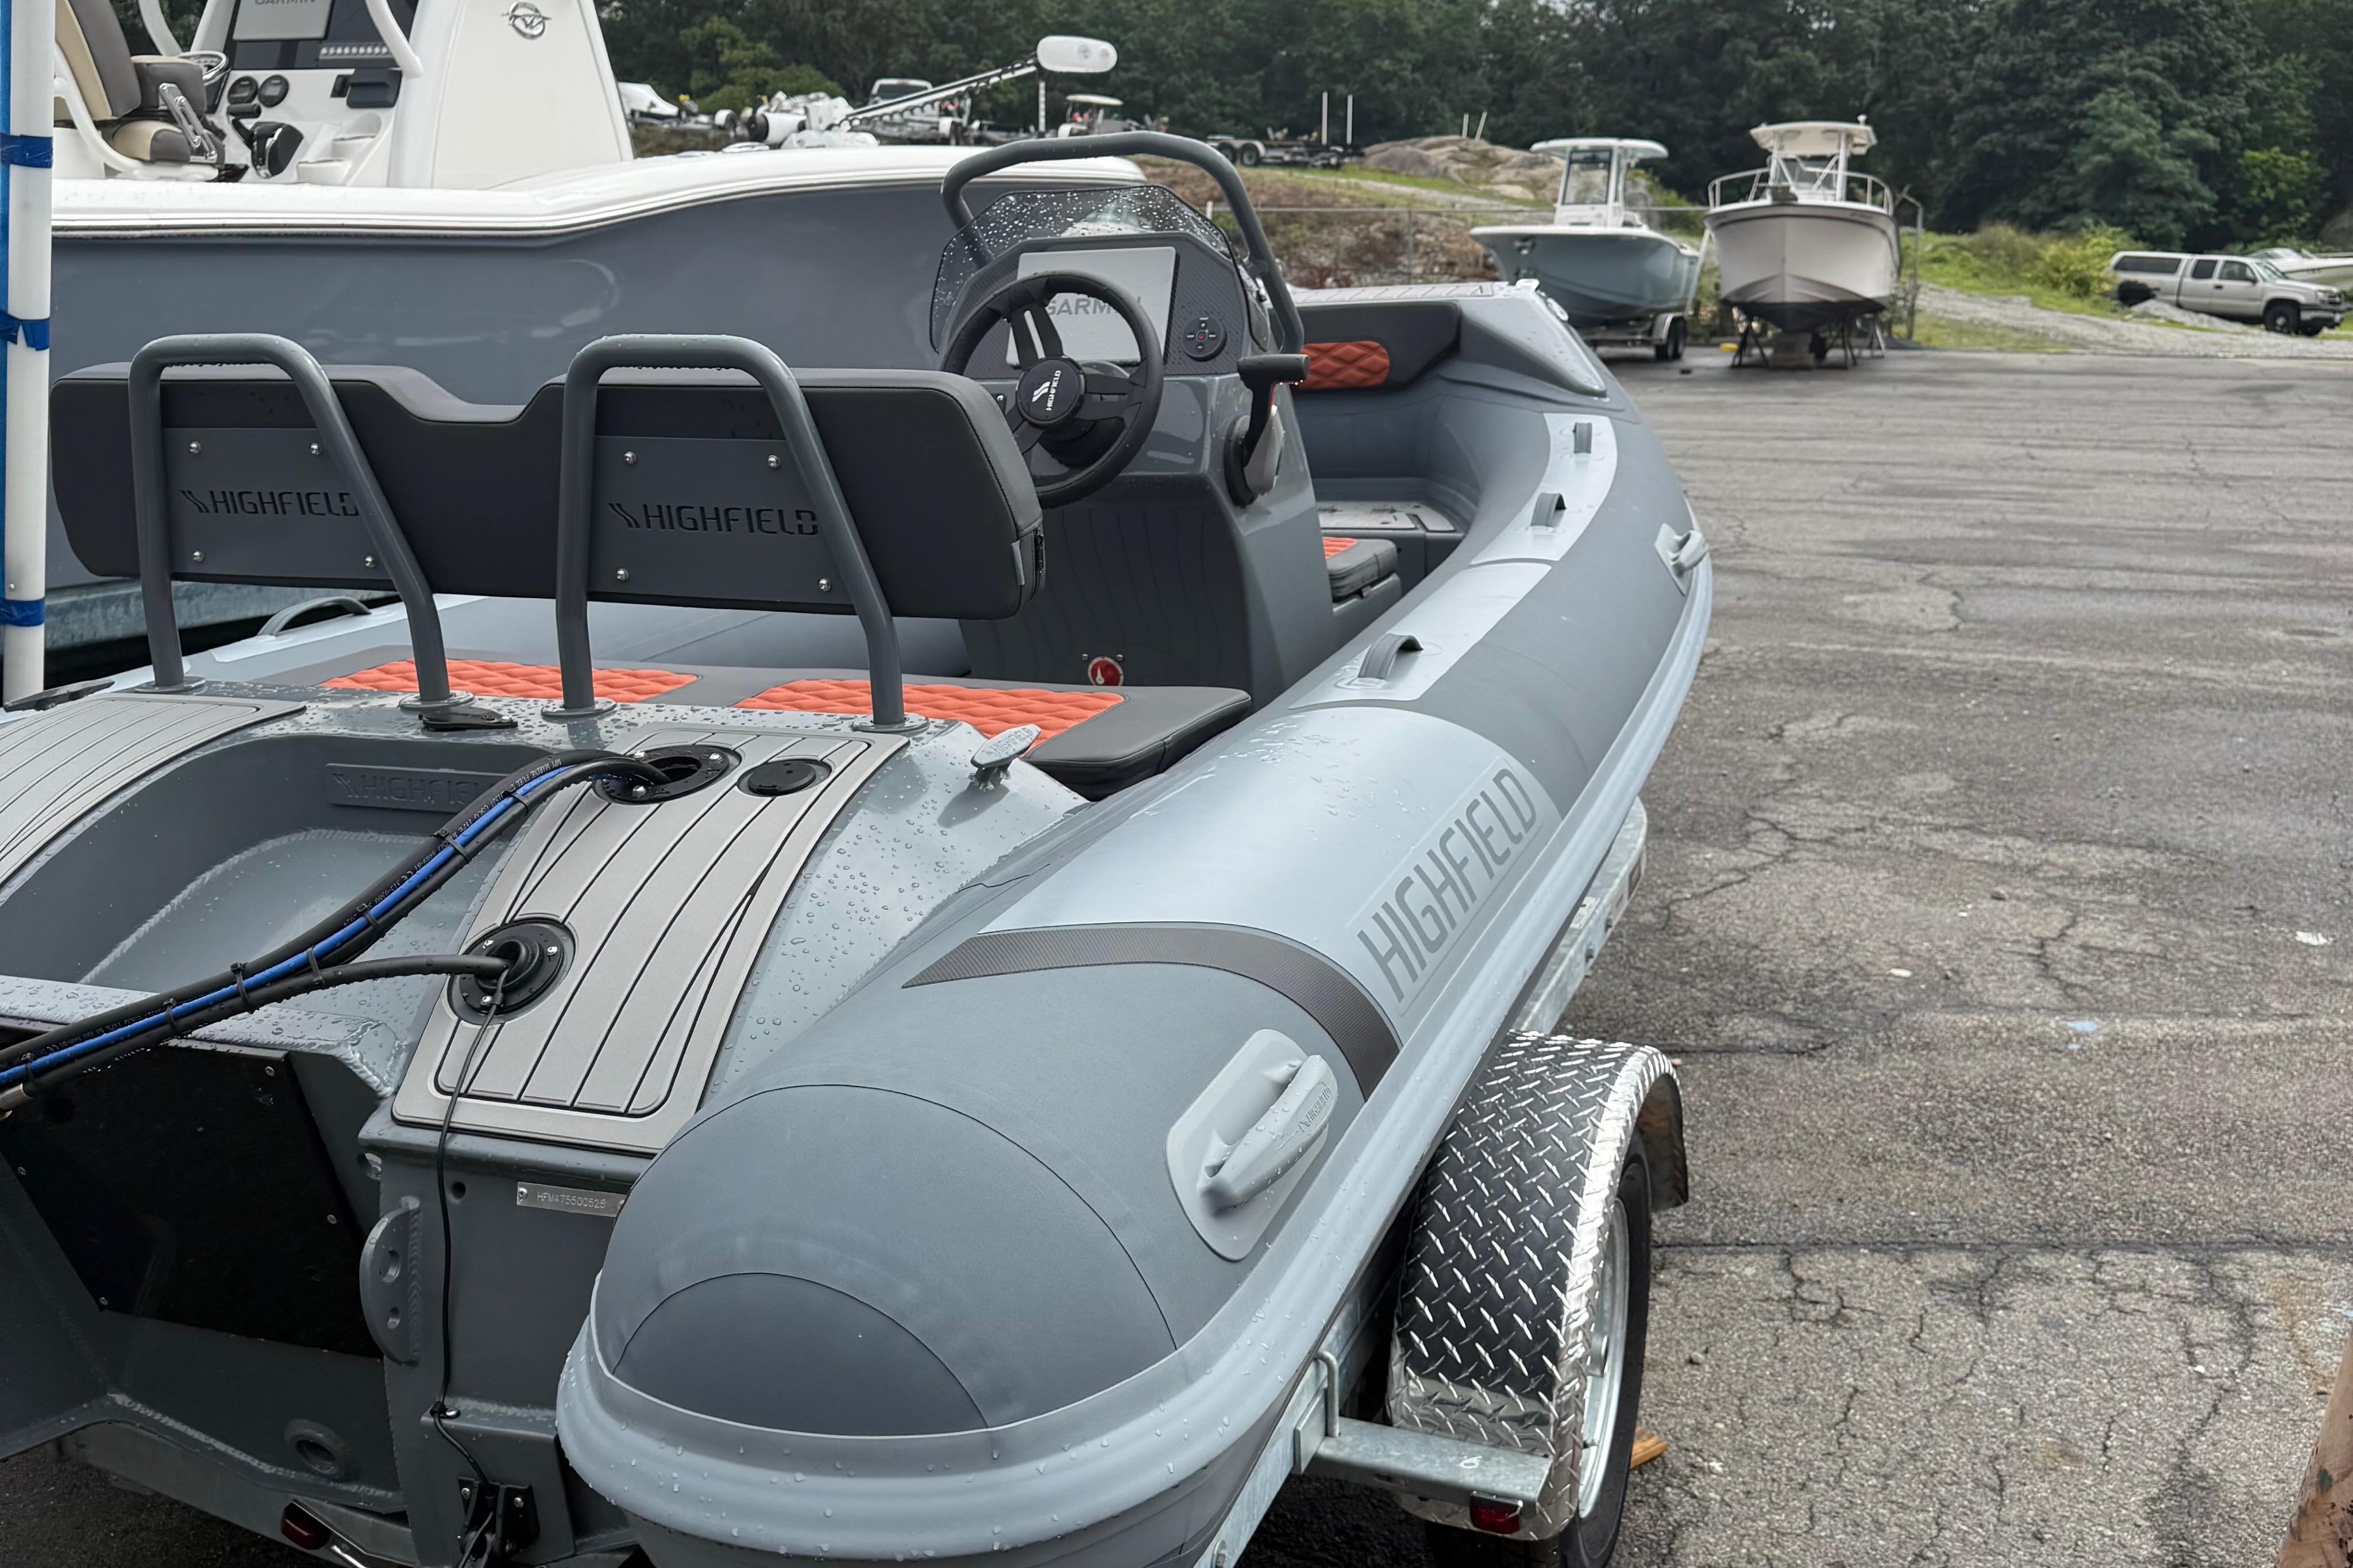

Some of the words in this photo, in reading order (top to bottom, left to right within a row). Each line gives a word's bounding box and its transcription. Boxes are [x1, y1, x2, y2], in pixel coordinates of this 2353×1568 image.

[1046, 296, 1141, 315] GARM
[209, 490, 360, 517] HIGHFIELD
[642, 504, 819, 535] HIGHFIELD
[1356, 768, 1537, 1003] HIGHFIELD
